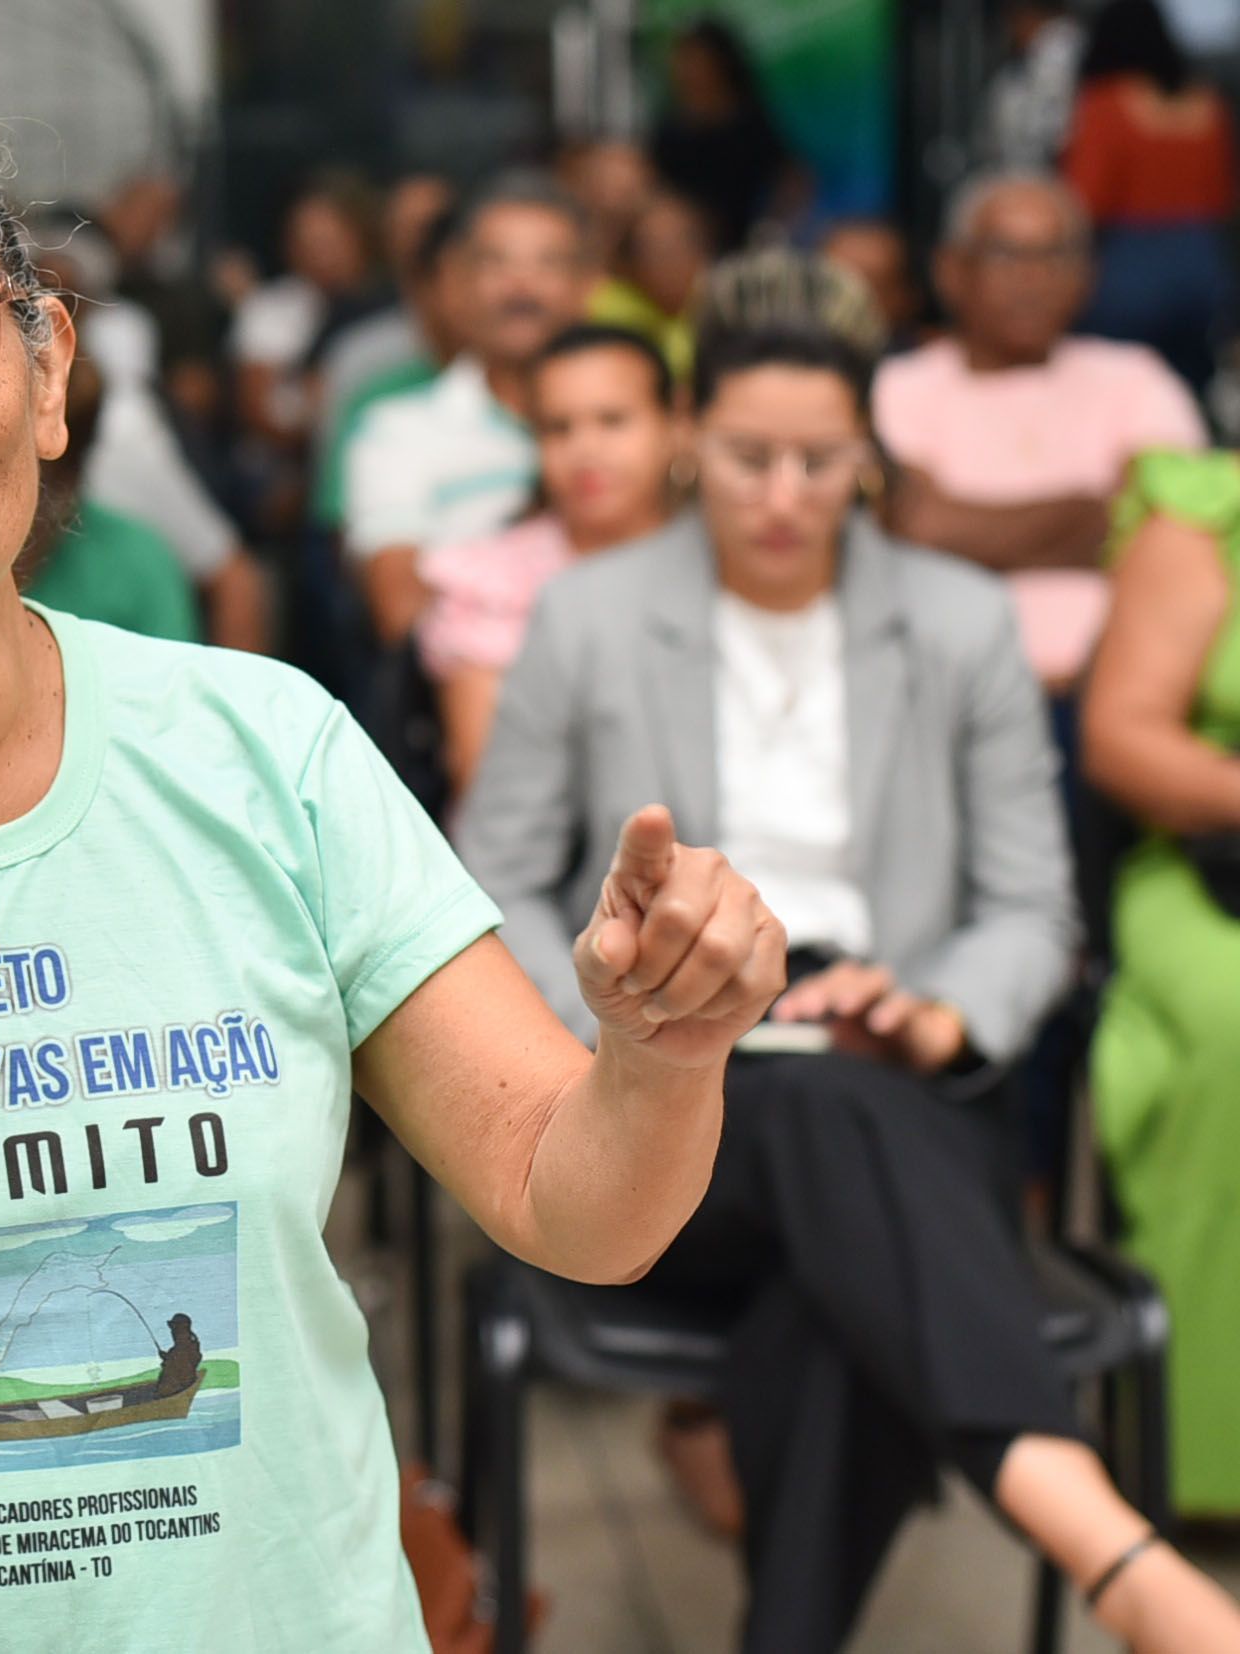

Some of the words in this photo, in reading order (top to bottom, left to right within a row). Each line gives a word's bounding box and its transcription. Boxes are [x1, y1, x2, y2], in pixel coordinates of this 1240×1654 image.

[79, 1031, 156, 1095] EM
[169, 1014, 278, 1094] AÇÃO
[77, 1485, 198, 1518] PROFISSIONAIS
[17, 1525, 107, 1555] MIRACEMA
[111, 1522, 132, 1545] DO
[135, 1512, 221, 1542] TOCANTINS
[91, 1555, 113, 1578] TO
